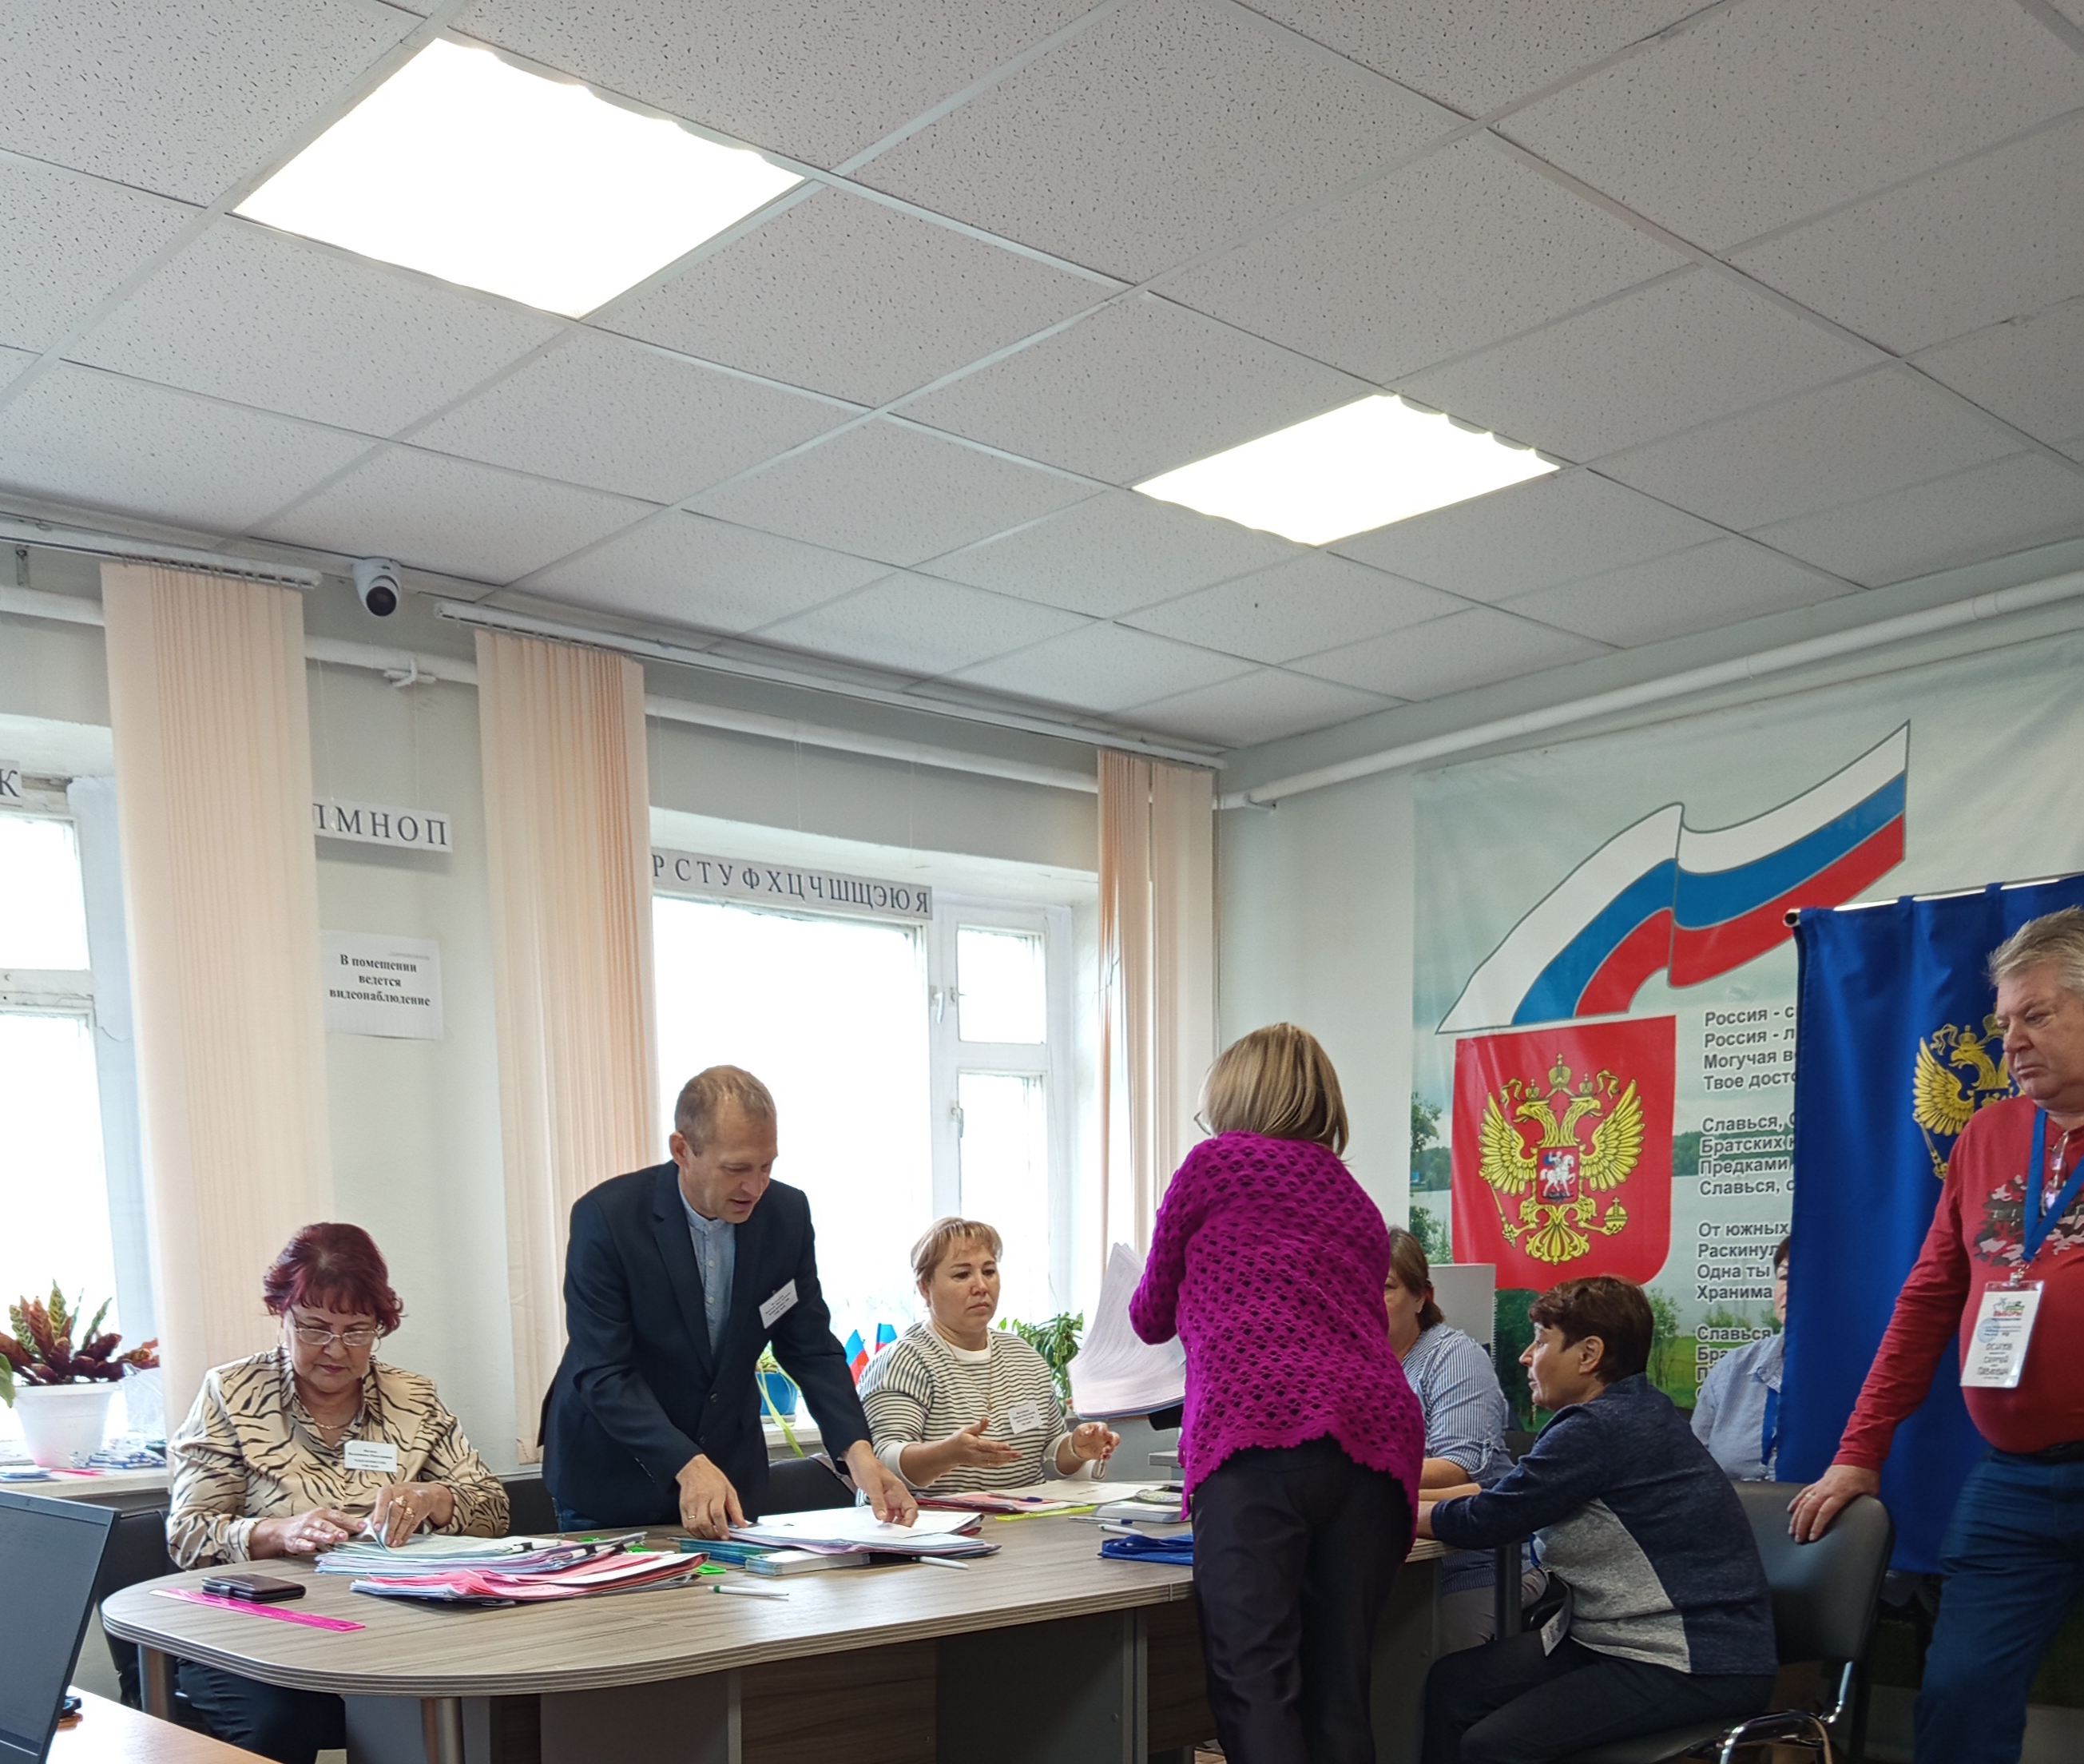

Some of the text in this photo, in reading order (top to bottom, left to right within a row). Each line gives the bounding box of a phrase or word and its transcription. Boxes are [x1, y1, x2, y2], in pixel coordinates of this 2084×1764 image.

[340, 954, 417, 973] В помещении
[359, 975, 401, 987] ведется
[329, 988, 431, 1007] видеонаблюдение
[1705, 1009, 1768, 1027] Россия
[1704, 1031, 1767, 1048] Россия
[1704, 1051, 1796, 1071] Могучая в
[1704, 1075, 1744, 1091] Твое
[1702, 1116, 1783, 1132] Славься,
[1701, 1138, 1783, 1157] Братских
[1700, 1159, 1788, 1178] Предками
[1700, 1181, 1780, 1196] Славься,
[1698, 1222, 1789, 1237] От южных
[1698, 1244, 1780, 1260] Раскинул
[1697, 1264, 1770, 1281] Одна ты
[1697, 1285, 1772, 1303] Хранима
[1697, 1326, 1771, 1341] Славься
